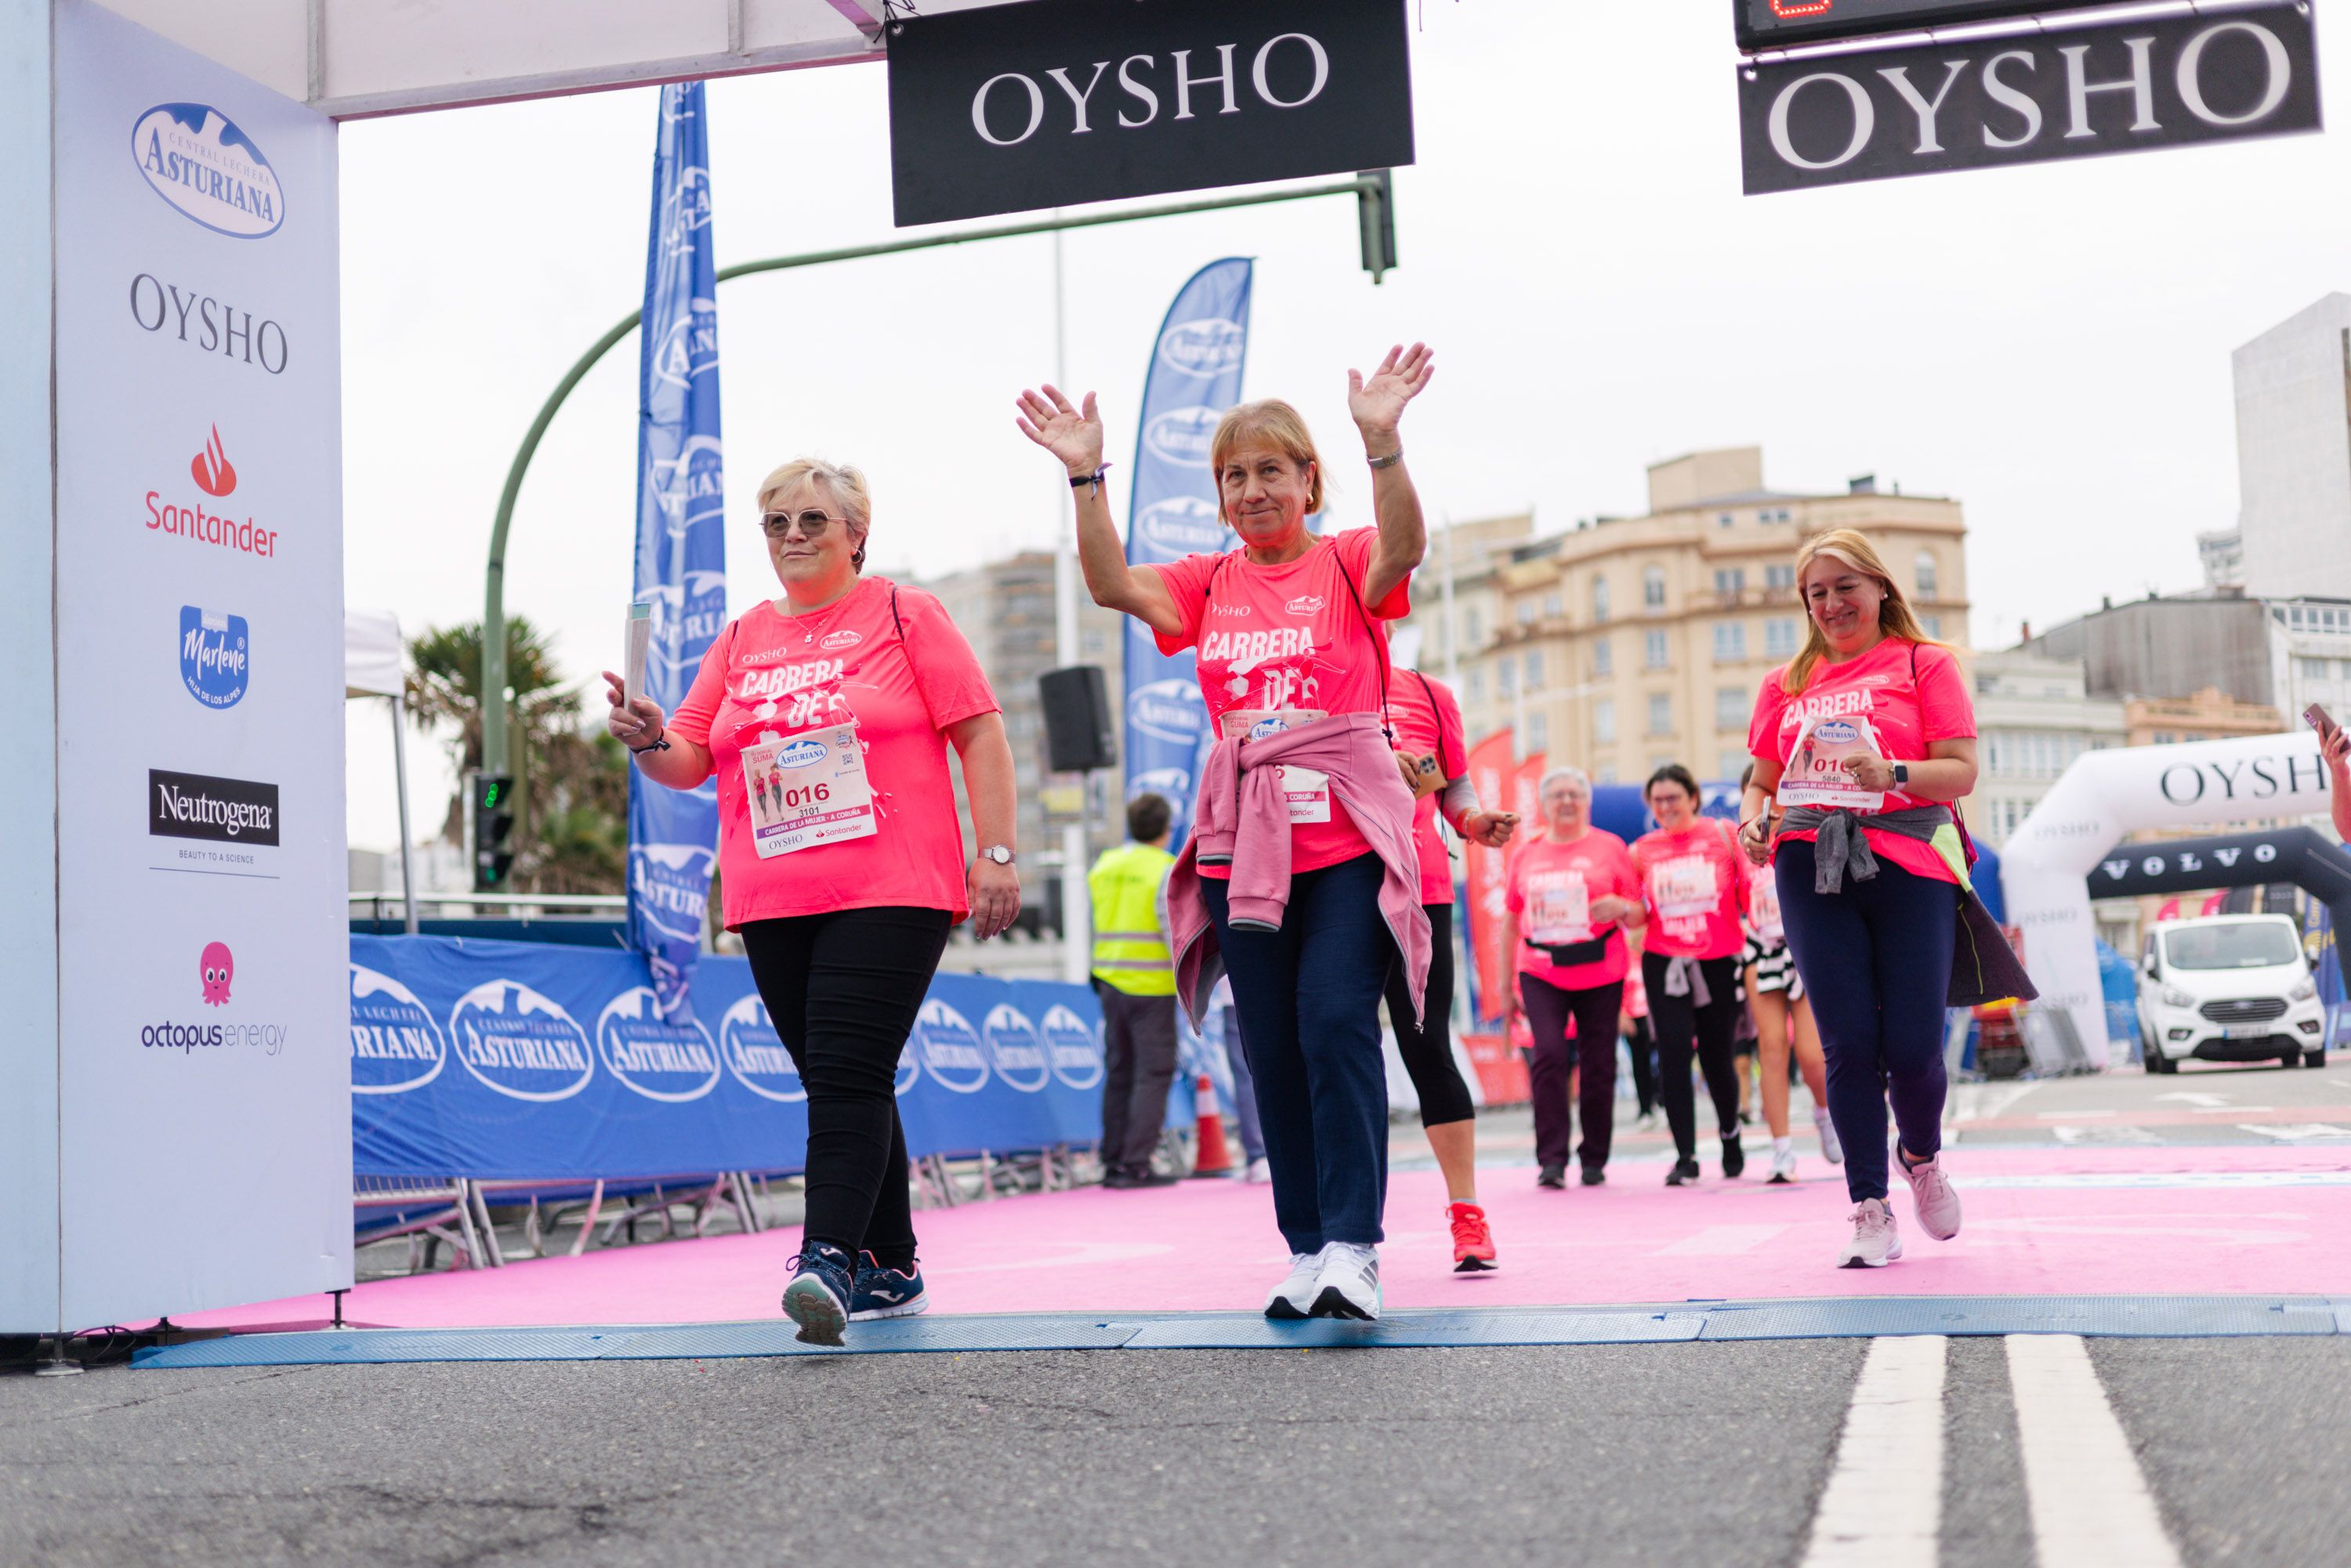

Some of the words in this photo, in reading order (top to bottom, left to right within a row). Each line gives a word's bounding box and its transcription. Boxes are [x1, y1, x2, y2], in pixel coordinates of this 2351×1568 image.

[972, 33, 1329, 146] OYSHO
[1768, 21, 2291, 169] OYSHO
[169, 132, 219, 163] CENTRAL
[223, 158, 270, 186] LECHERA
[144, 126, 274, 223] ASTURIANA
[130, 273, 288, 375] OYSHO
[145, 490, 277, 558] Santander
[183, 628, 245, 680] Marlene
[741, 646, 788, 664] OYSHO
[187, 675, 201, 697] HIJA
[201, 690, 210, 703] DE
[211, 695, 223, 704] LOS
[223, 686, 241, 704] ALPES
[1817, 729, 1856, 739] ASTURIANA
[752, 753, 774, 764] SUMA
[780, 749, 824, 766] ASTURIANA
[2160, 752, 2327, 807] OYSH
[158, 784, 271, 835] Neutrogena
[785, 782, 830, 808] 016
[1289, 791, 1316, 801] CORUÑA
[1788, 791, 1820, 800] OYSHO
[765, 824, 789, 836] CARRERA
[805, 816, 826, 826] MUJER
[836, 808, 861, 820] CORUÑA
[799, 806, 820, 818] 3101
[1290, 808, 1315, 817] tander
[769, 834, 803, 850] OYSHO
[825, 824, 862, 837] Santander
[179, 849, 206, 860] BEAUTY
[208, 852, 217, 861] TO
[219, 853, 224, 862] A
[226, 853, 254, 864] SCIENCE
[2103, 843, 2277, 880] VOLVO
[141, 1020, 223, 1055] octopus
[224, 1024, 288, 1056] energy
[350, 1024, 439, 1061] RIANA
[464, 1018, 588, 1071] ASTURIANA
